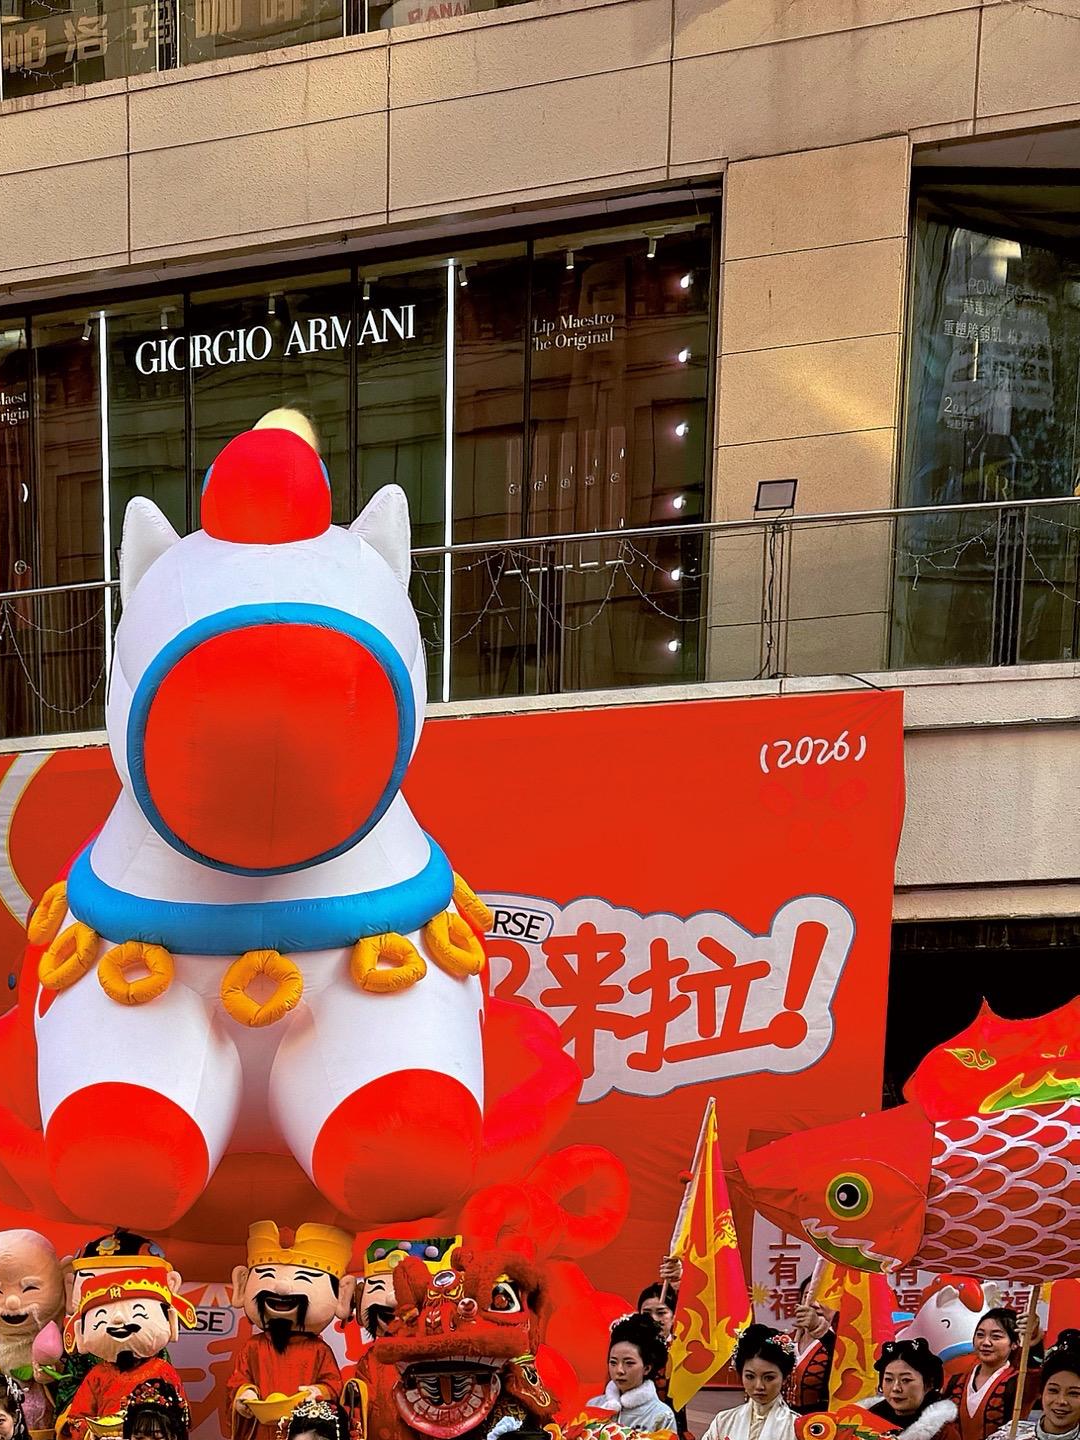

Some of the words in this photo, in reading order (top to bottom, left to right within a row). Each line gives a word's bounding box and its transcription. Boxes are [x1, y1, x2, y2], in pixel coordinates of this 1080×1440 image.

[135, 325, 272, 375] GIORGIO
[284, 304, 416, 356] ARMANI
[533, 319, 555, 336] Lip
[560, 313, 615, 330] Maestro
[555, 326, 613, 351] Original
[760, 730, 868, 774] (2026)
